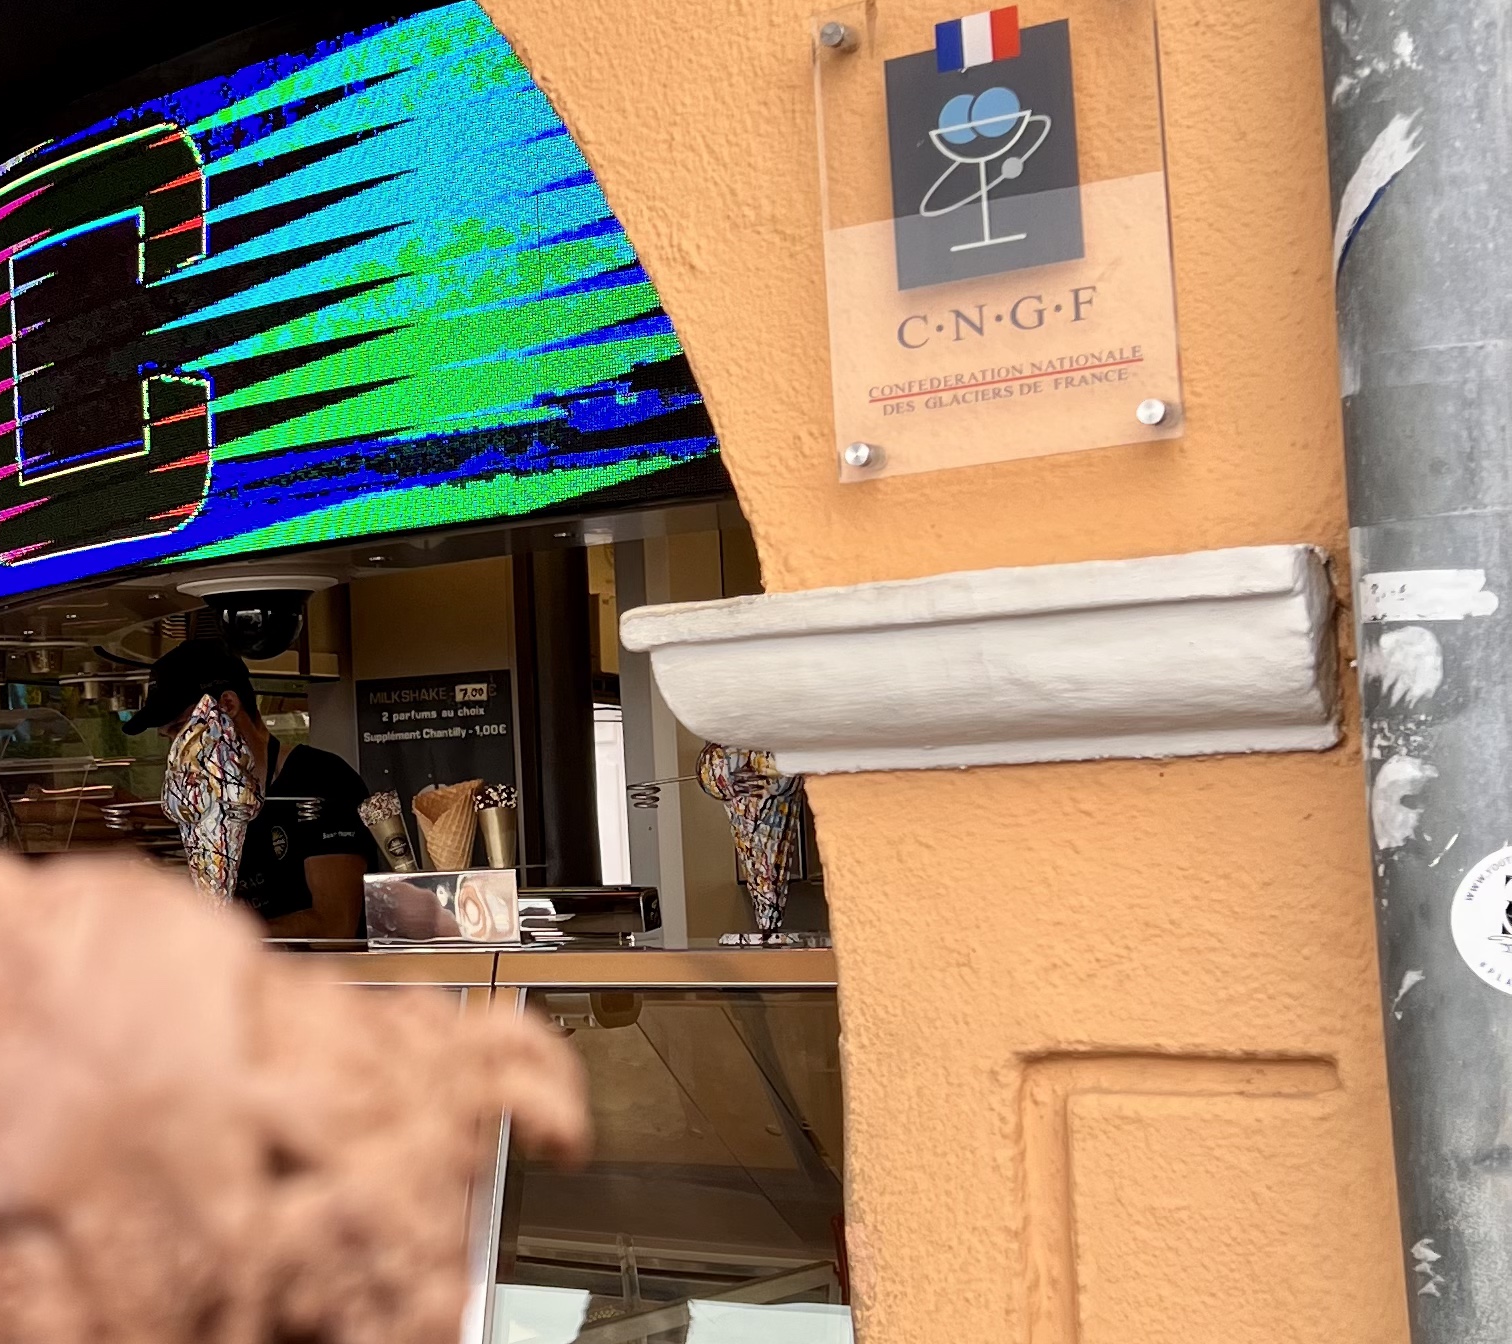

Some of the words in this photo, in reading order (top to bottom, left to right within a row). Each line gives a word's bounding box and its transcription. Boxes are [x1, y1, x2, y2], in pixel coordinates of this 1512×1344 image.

[867, 362, 1025, 400] CONFEDERATION
[1029, 344, 1143, 376] NATIONALE
[882, 399, 916, 417] DES
[924, 385, 1014, 411] GLACIERS
[1018, 380, 1044, 396] DE
[1053, 367, 1129, 392] FRANCE
[369, 687, 447, 705] MILKSHAKE
[381, 712, 389, 722] 2
[392, 710, 437, 723] parfums
[441, 710, 454, 718] au
[457, 706, 485, 718] choix
[363, 730, 422, 744] Supplément
[422, 726, 467, 739] Chantilly
